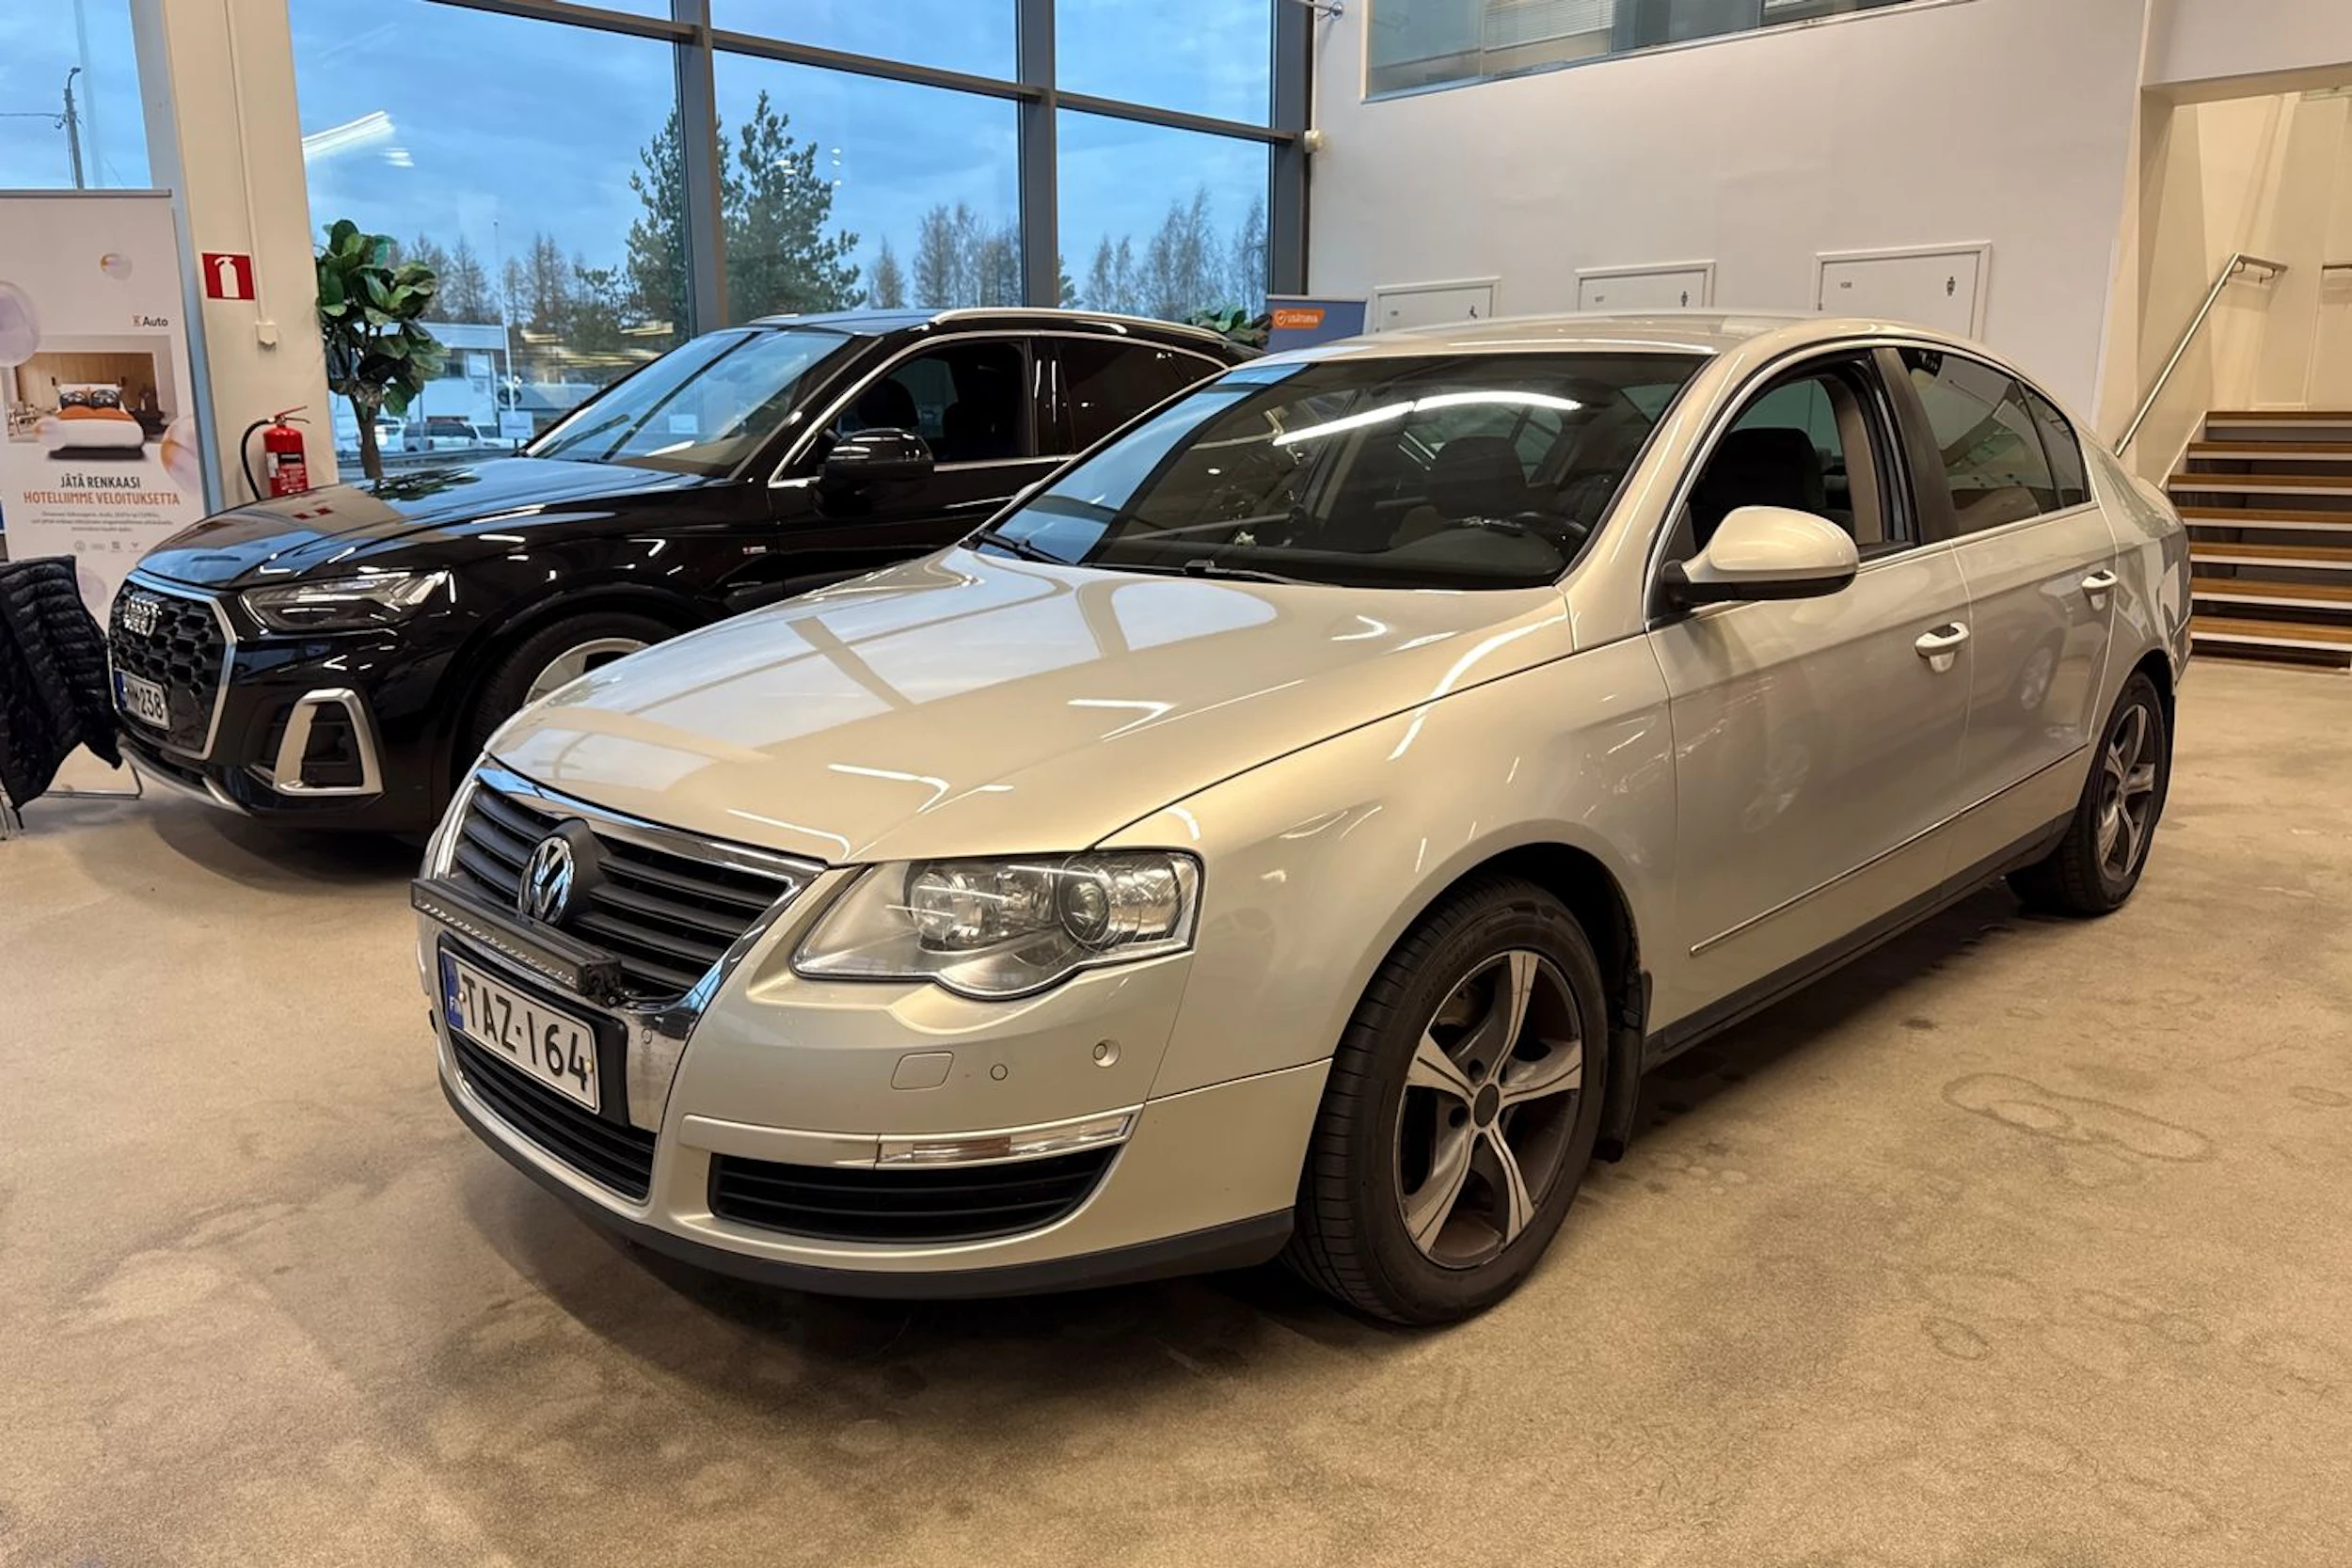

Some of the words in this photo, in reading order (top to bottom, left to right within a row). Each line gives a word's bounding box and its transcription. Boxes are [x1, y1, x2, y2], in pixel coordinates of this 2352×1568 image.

[142, 316, 168, 326] Auto
[60, 473, 86, 488] JÄTÄ
[87, 476, 140, 488] RENKAASI
[24, 490, 93, 504] HOTELLIIMME
[96, 492, 181, 504] VELOITUKSETTA
[461, 973, 588, 1093] TAZ-164
